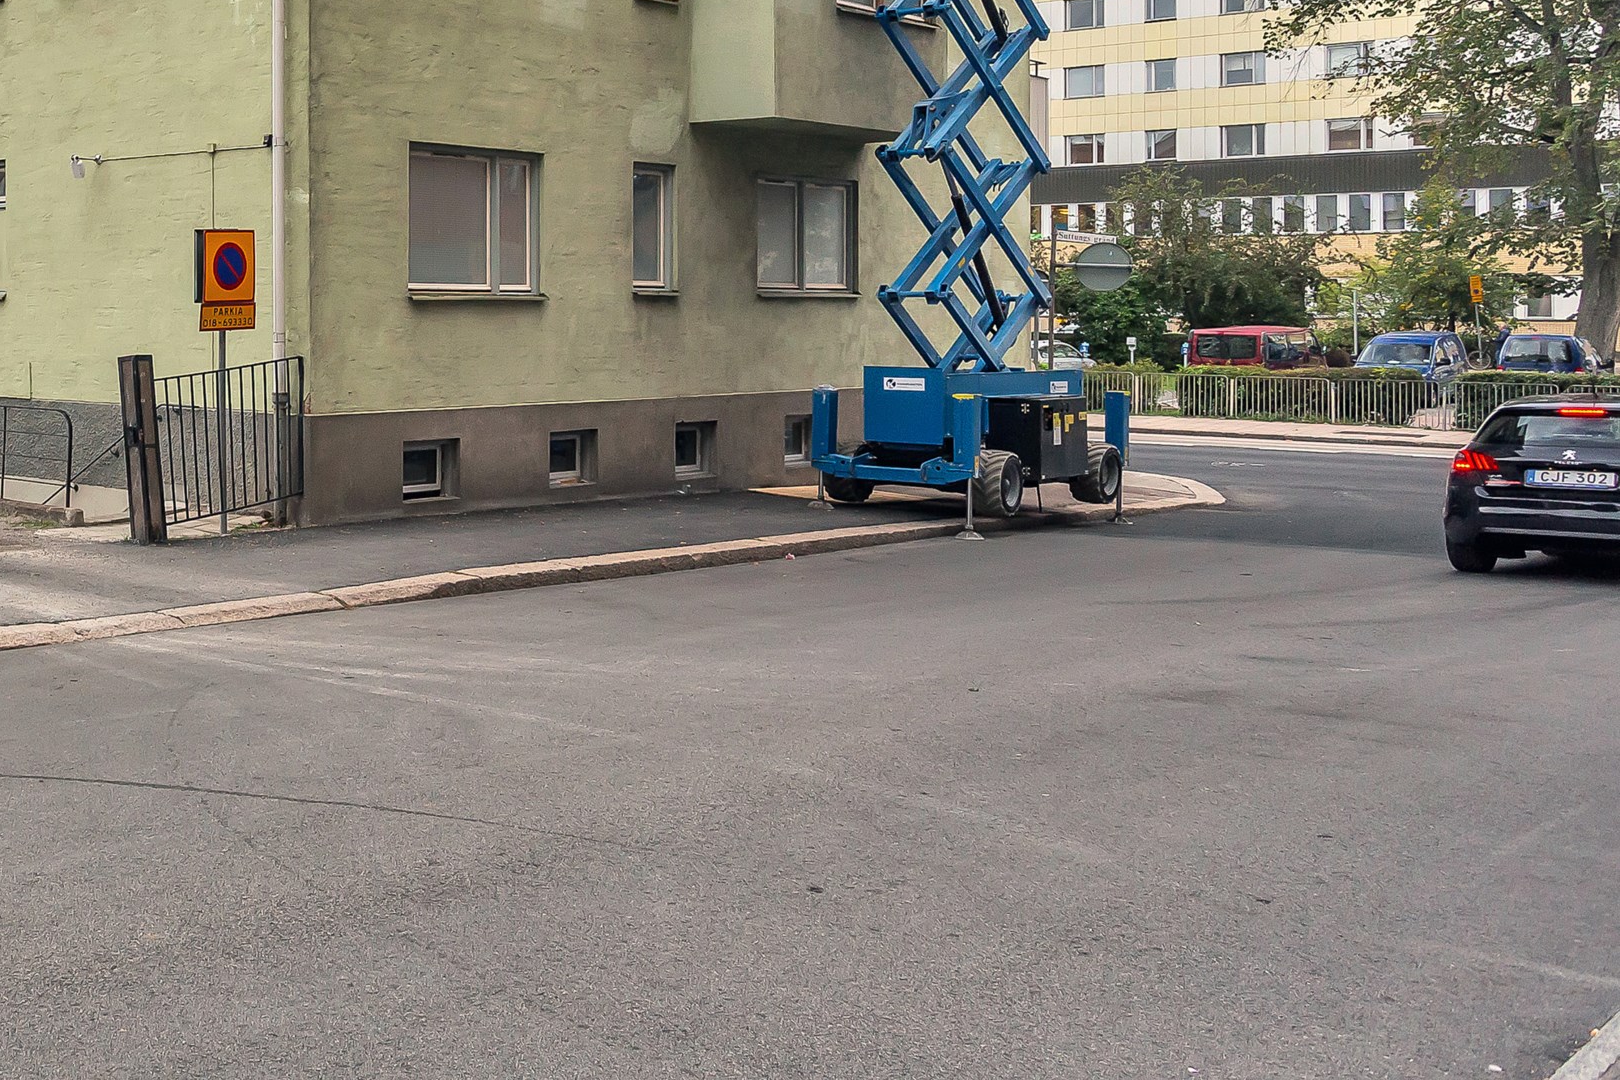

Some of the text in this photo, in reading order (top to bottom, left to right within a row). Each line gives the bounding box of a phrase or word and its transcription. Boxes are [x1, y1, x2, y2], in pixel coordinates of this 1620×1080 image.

[1057, 231, 1091, 242] Suttungs
[213, 307, 243, 316] PARKIA
[202, 316, 253, 327] 018-693330
[1540, 471, 1608, 485] CJF 302
